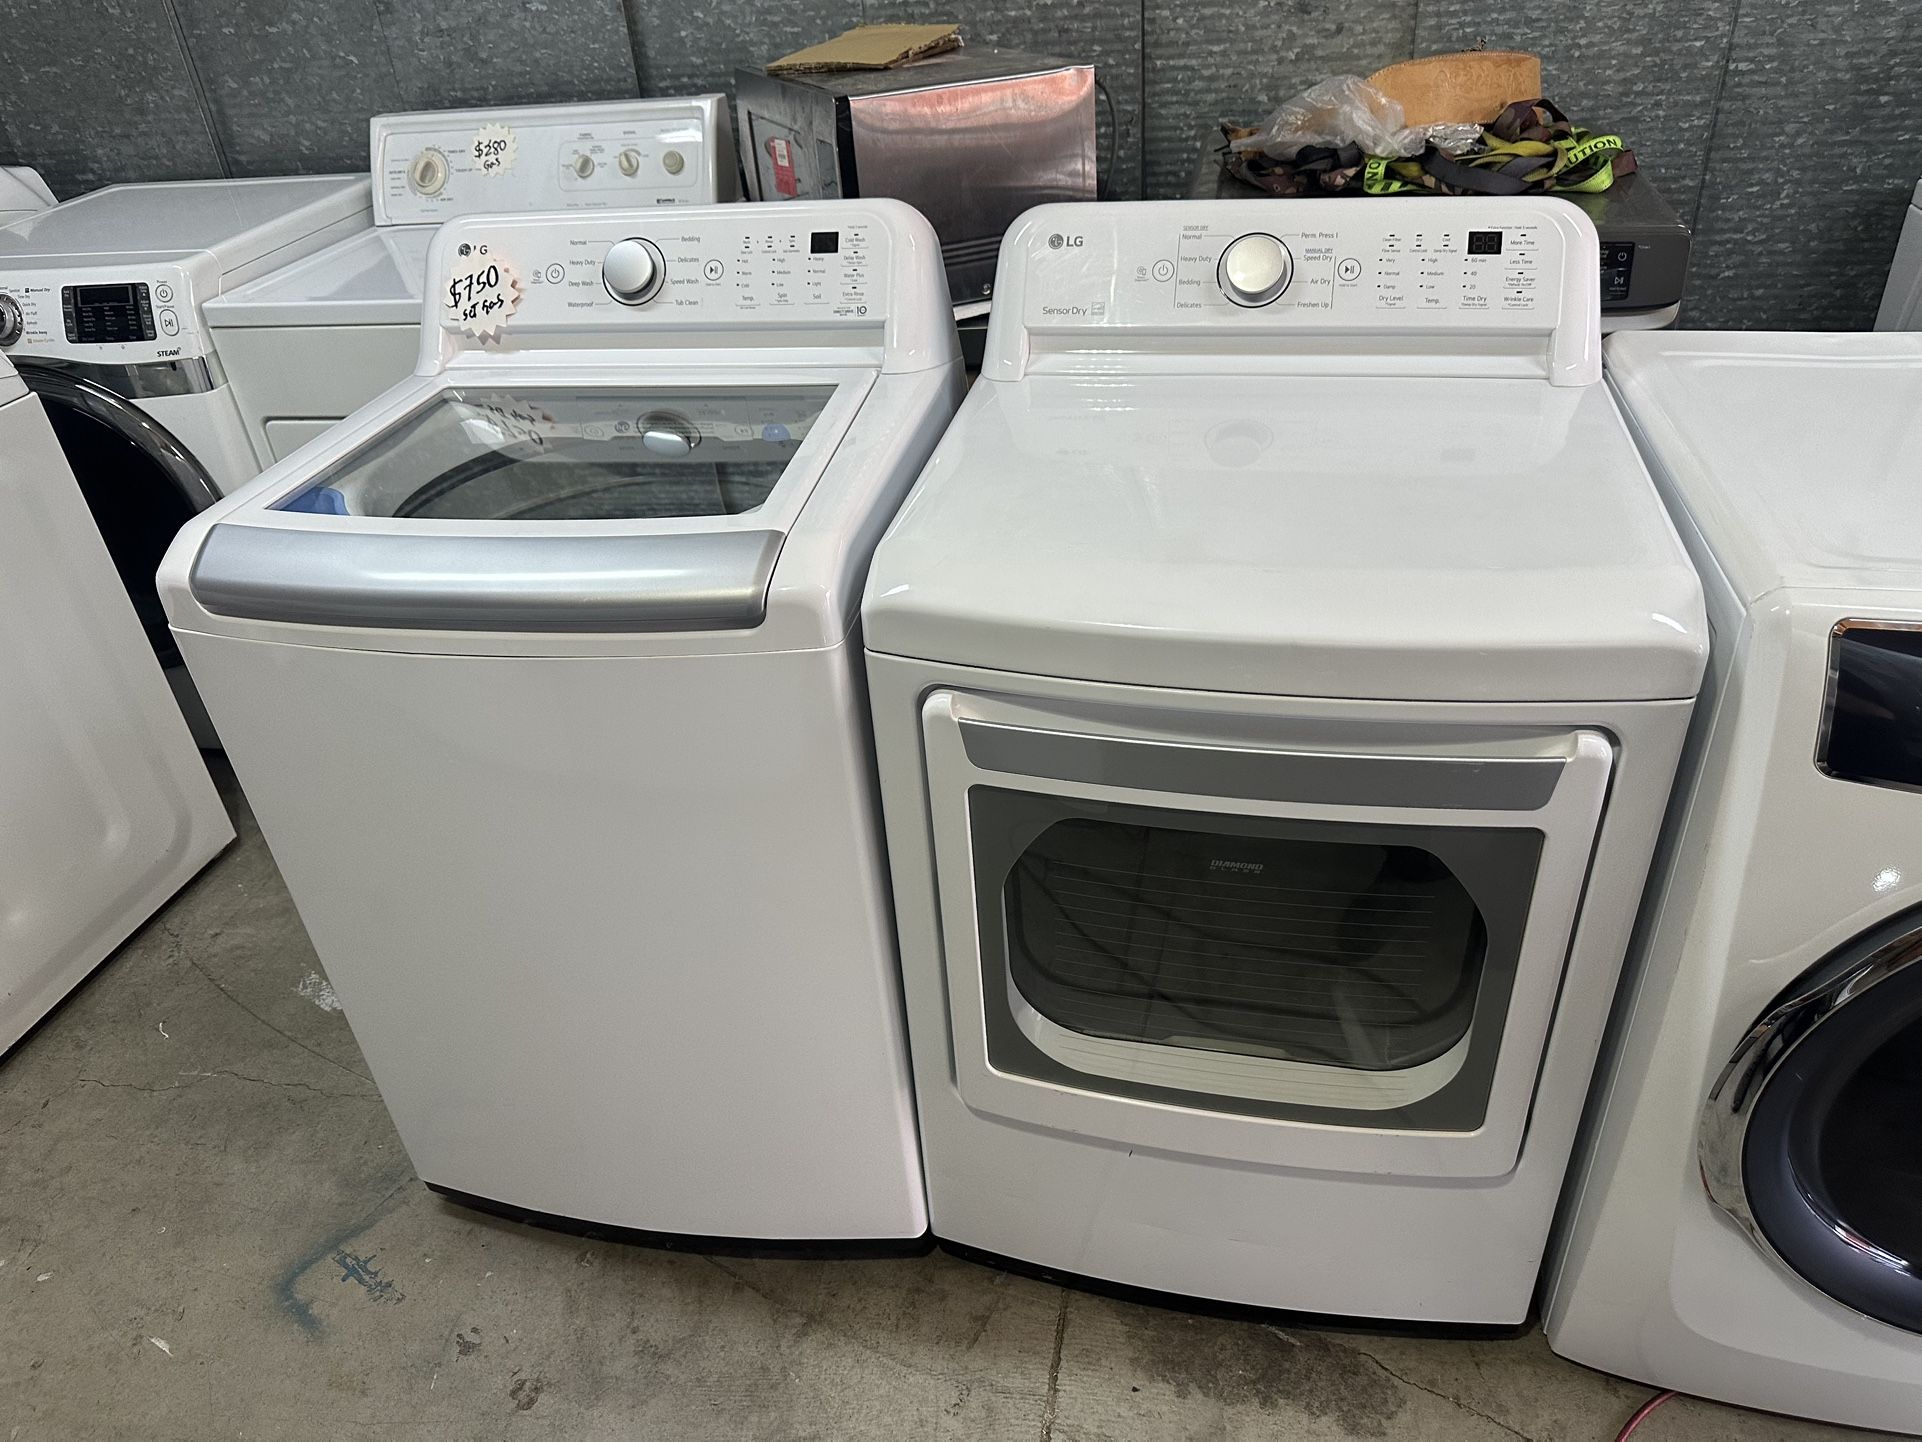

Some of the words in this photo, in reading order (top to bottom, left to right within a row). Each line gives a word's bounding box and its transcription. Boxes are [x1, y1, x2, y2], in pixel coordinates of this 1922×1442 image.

[1565, 138, 1618, 167] UTION
[1066, 236, 1084, 248] LG
[447, 265, 499, 309] $750
[156, 349, 180, 358] STEAM
[1210, 860, 1264, 870] DIAMOND
